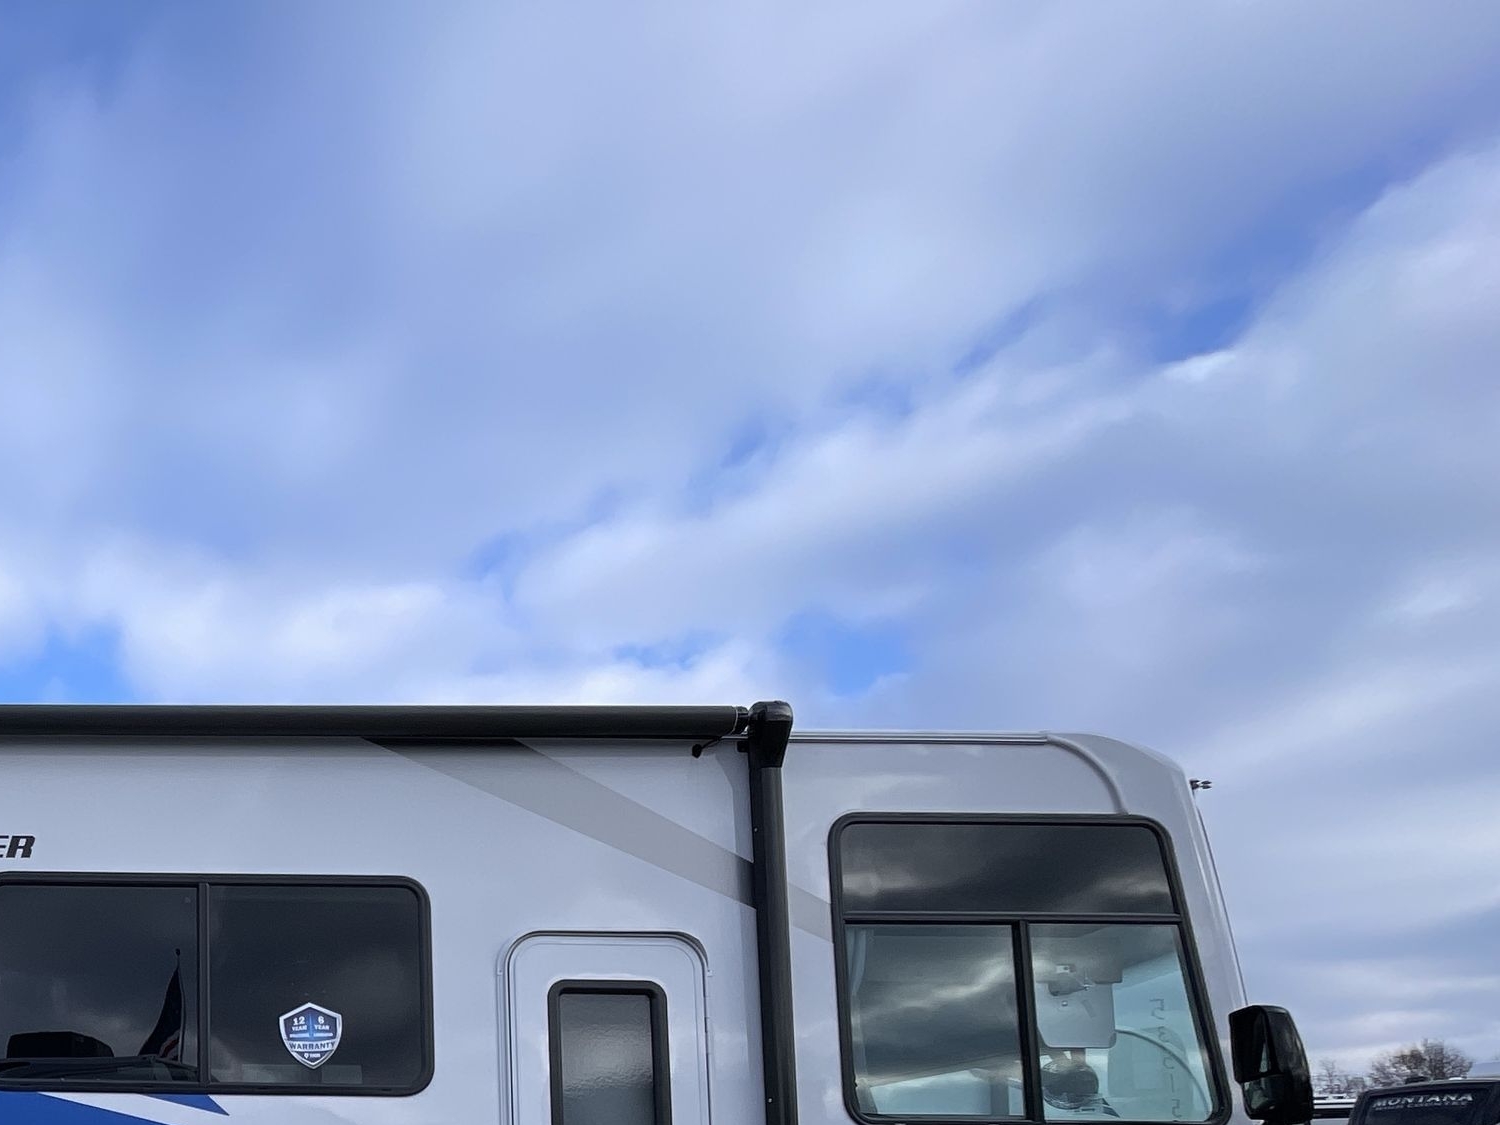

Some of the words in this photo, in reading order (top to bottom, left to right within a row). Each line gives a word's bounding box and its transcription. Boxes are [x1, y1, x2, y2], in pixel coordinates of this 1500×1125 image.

[293, 1016, 306, 1025] 12
[289, 1042, 334, 1050] WARRANTY
[1372, 1094, 1473, 1108] MONTANA
